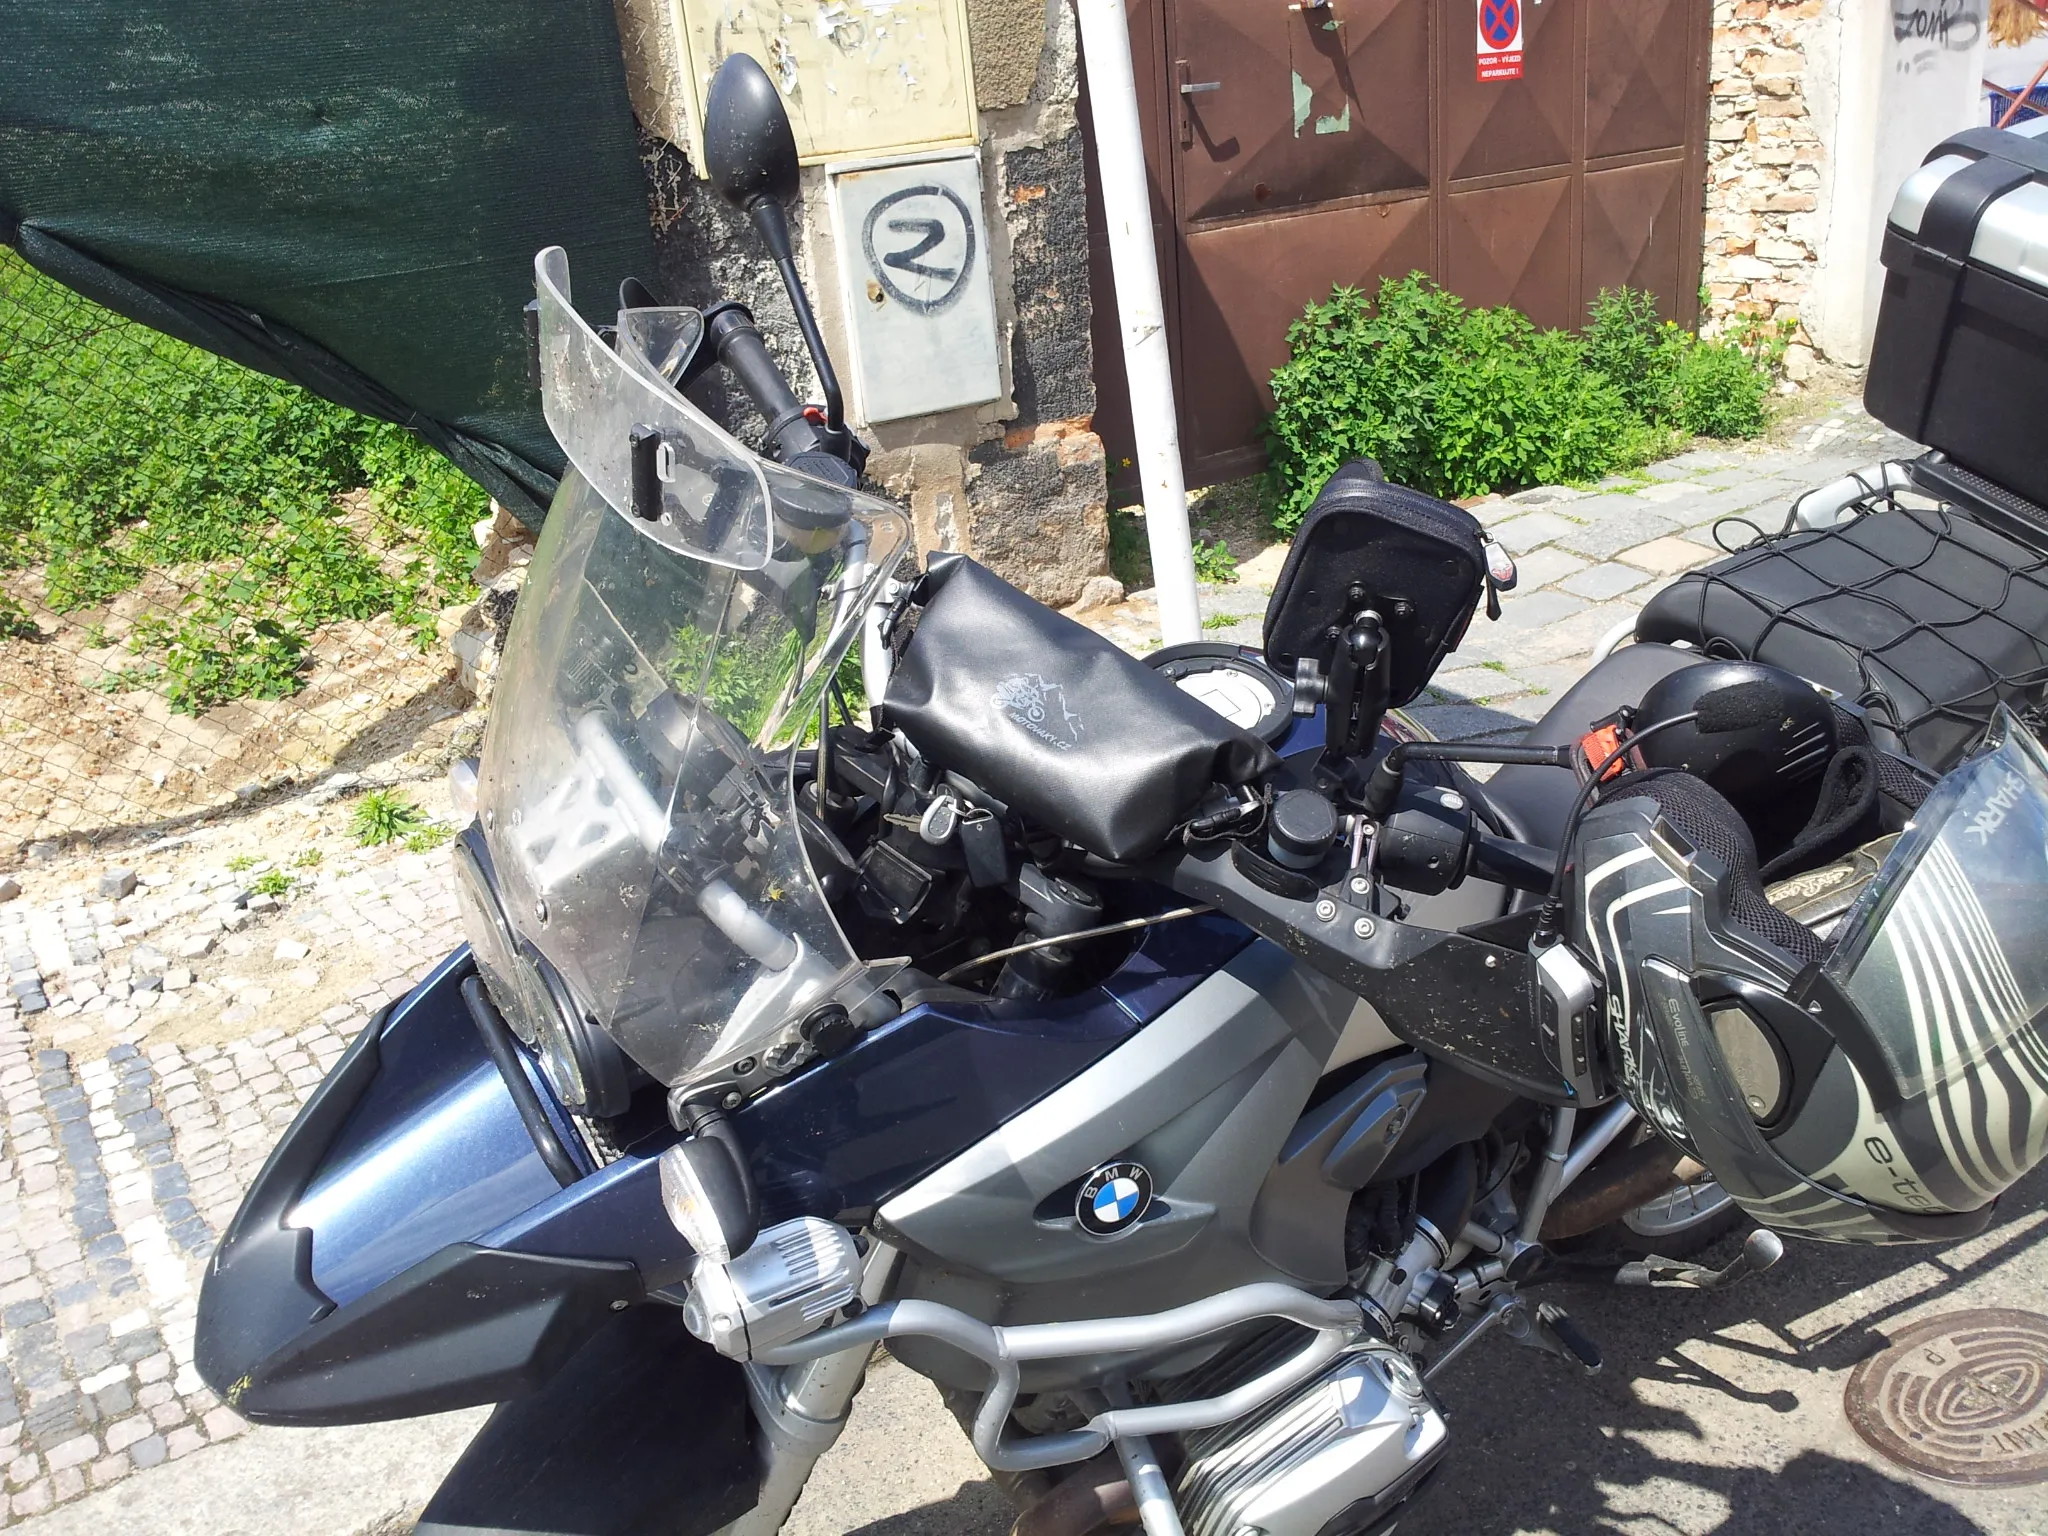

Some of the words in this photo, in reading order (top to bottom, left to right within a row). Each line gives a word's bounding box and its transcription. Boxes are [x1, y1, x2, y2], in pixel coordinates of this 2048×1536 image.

[1963, 771, 2025, 846] SHARK
[1609, 994, 1641, 1086] SHARK
[1084, 1166, 1144, 1199] BMW
